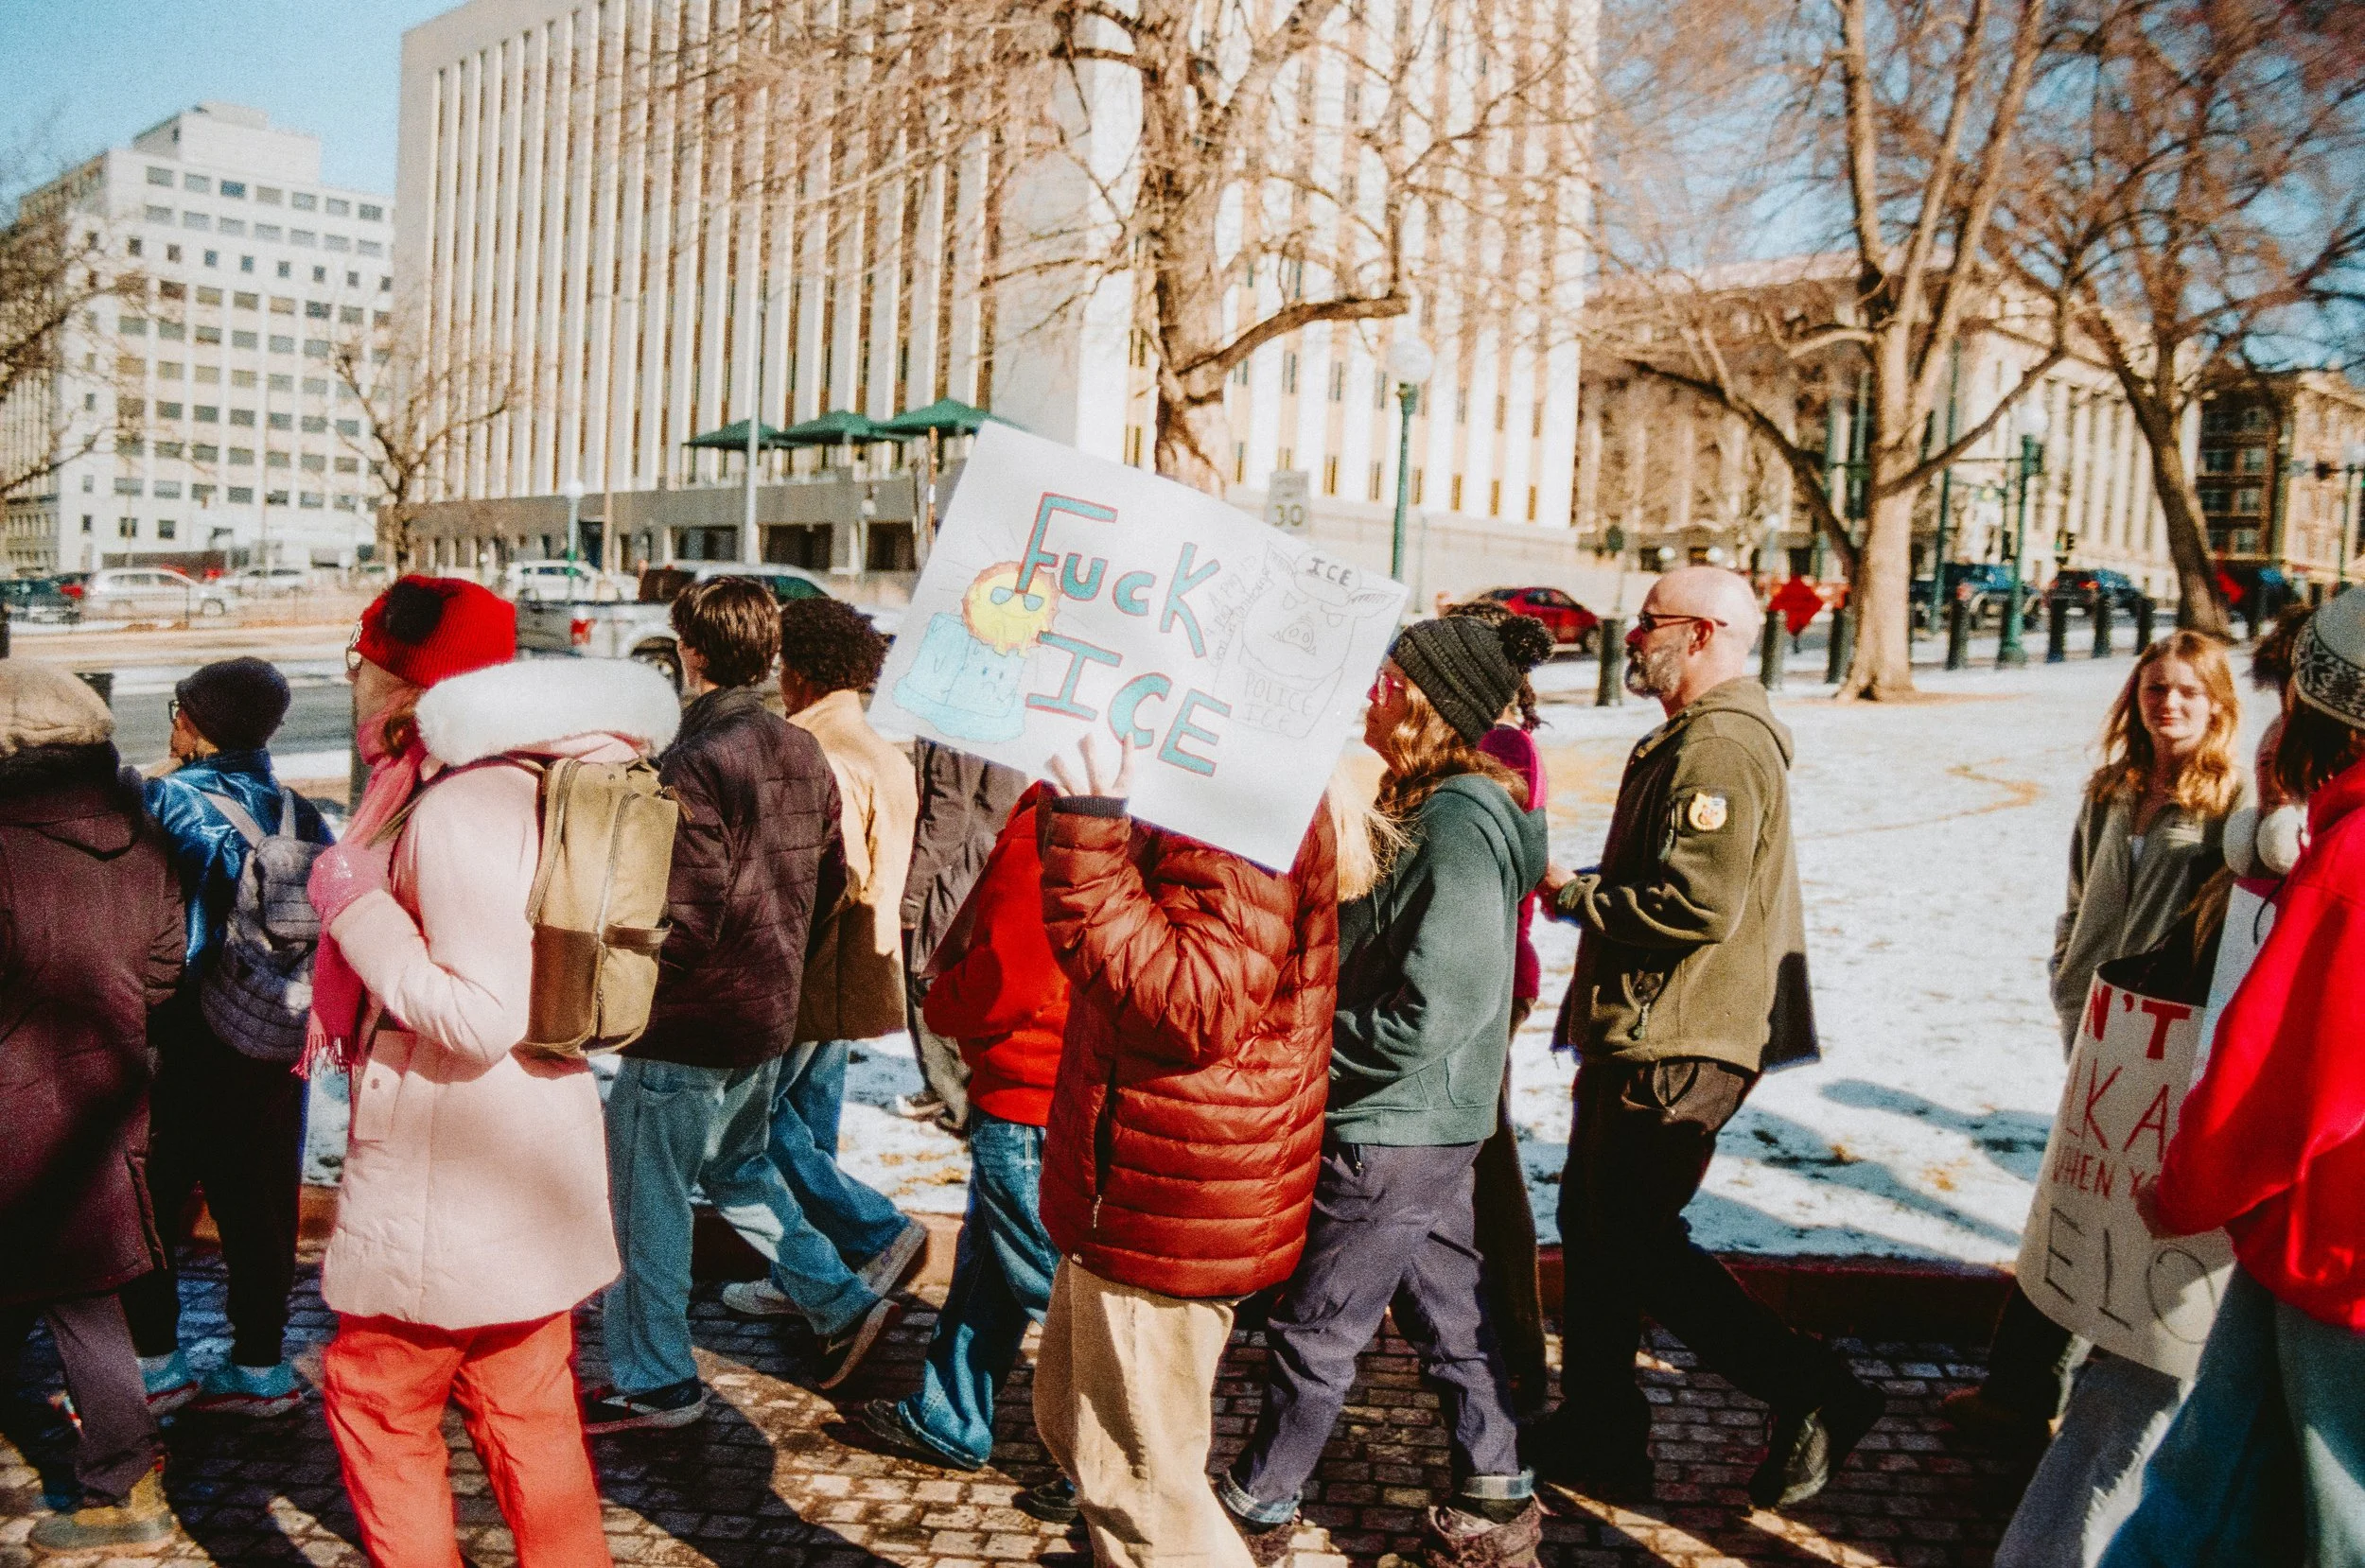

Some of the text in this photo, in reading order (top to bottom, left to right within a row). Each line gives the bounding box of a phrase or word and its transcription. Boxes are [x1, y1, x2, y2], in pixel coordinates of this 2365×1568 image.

[1271, 504, 1305, 527] 30
[1306, 557, 1353, 587] ICE
[1025, 630, 1233, 778] ICE
[1243, 670, 1313, 717] POLICE
[1238, 702, 1291, 733] ICE
